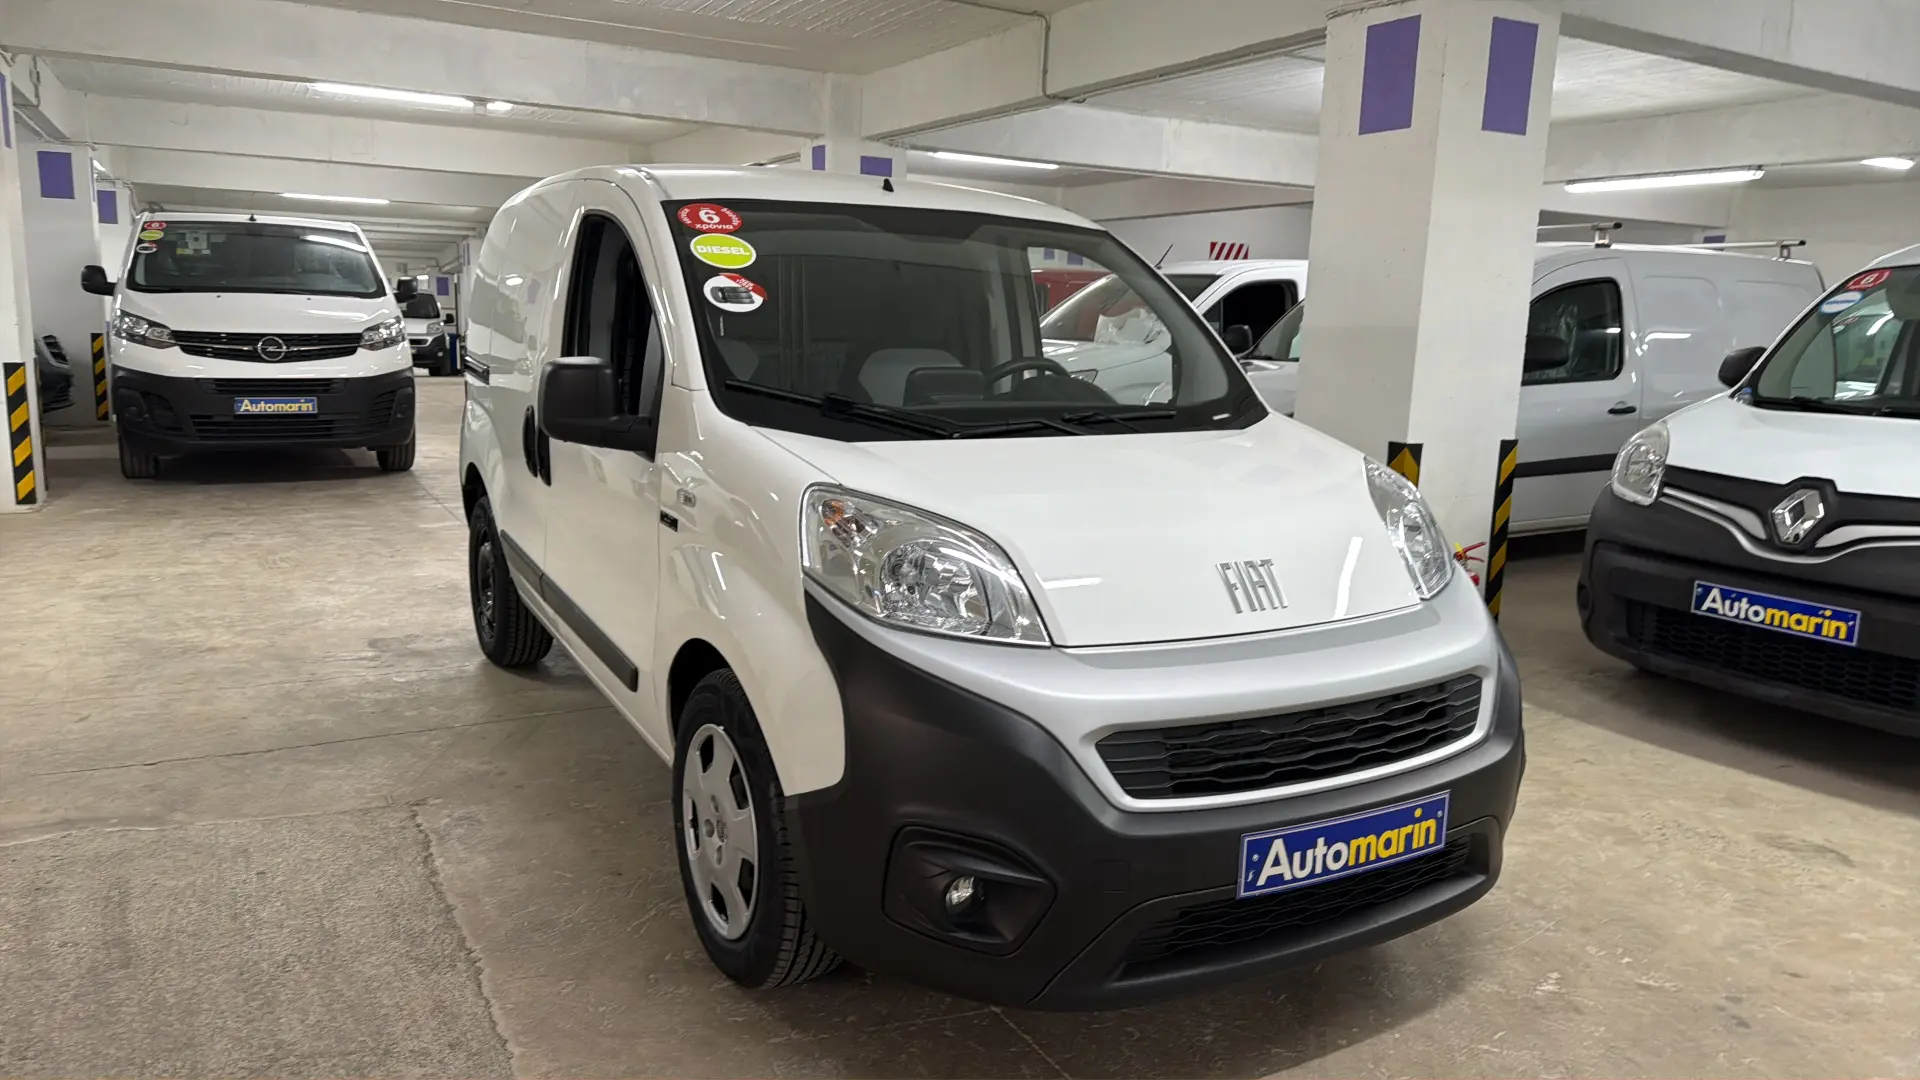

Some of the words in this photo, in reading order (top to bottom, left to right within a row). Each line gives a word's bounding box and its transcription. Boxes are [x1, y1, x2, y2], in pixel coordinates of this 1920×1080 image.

[698, 209, 720, 224] 6
[696, 245, 750, 255] DIESEL
[240, 399, 313, 412] Automarin
[1215, 559, 1288, 614] FIAT
[1701, 588, 1847, 640] Automarin
[1256, 807, 1437, 887] Automarin
